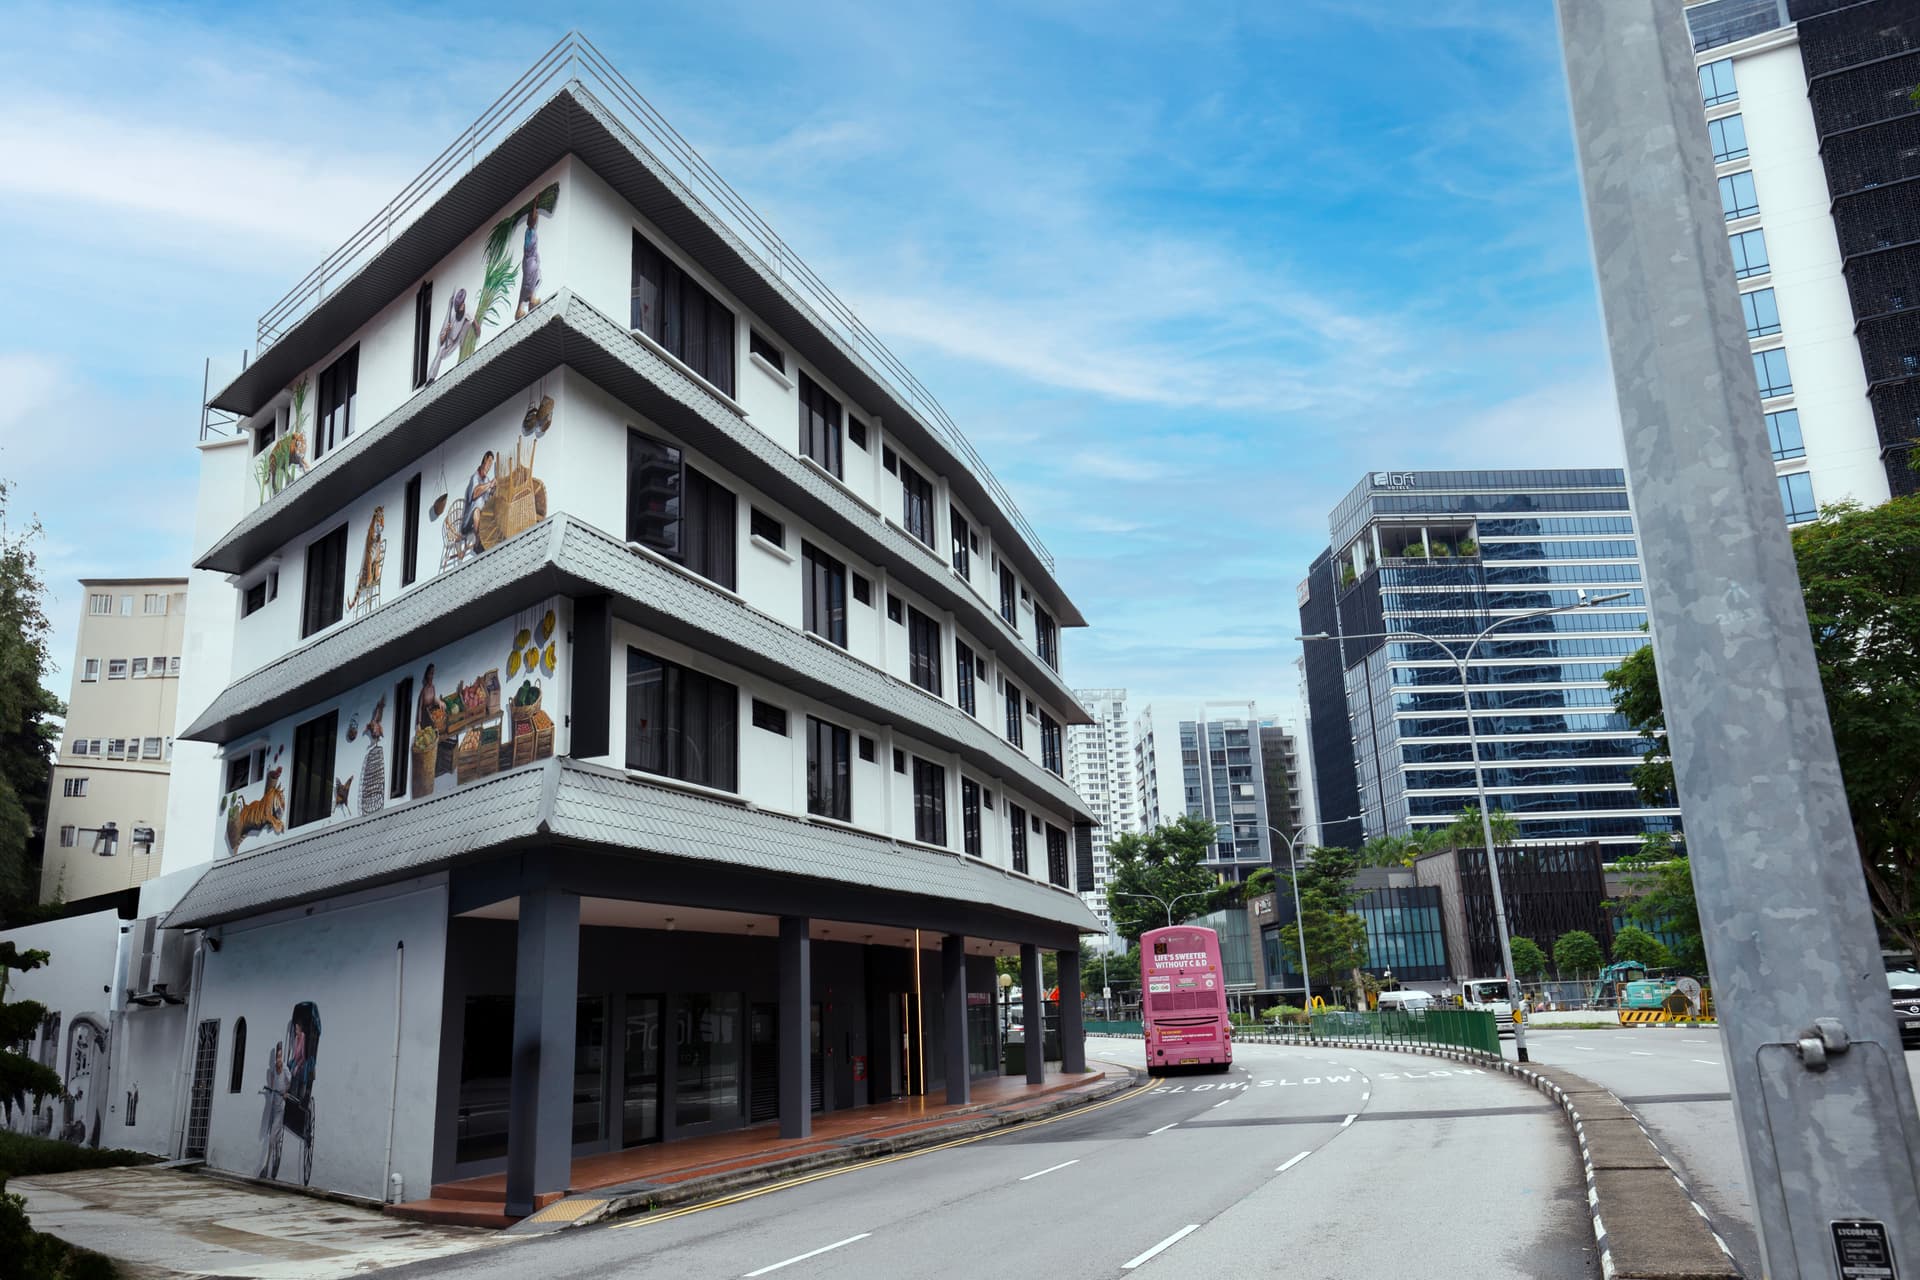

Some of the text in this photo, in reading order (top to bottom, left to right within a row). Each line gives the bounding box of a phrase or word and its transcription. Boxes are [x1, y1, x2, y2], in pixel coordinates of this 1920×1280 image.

[1154, 952, 1207, 962] LIFE'S SWEETER
[1155, 960, 1188, 969] WITHOUT
[1256, 1075, 1351, 1088] SLOW
[1149, 1081, 1246, 1095] SLOW
